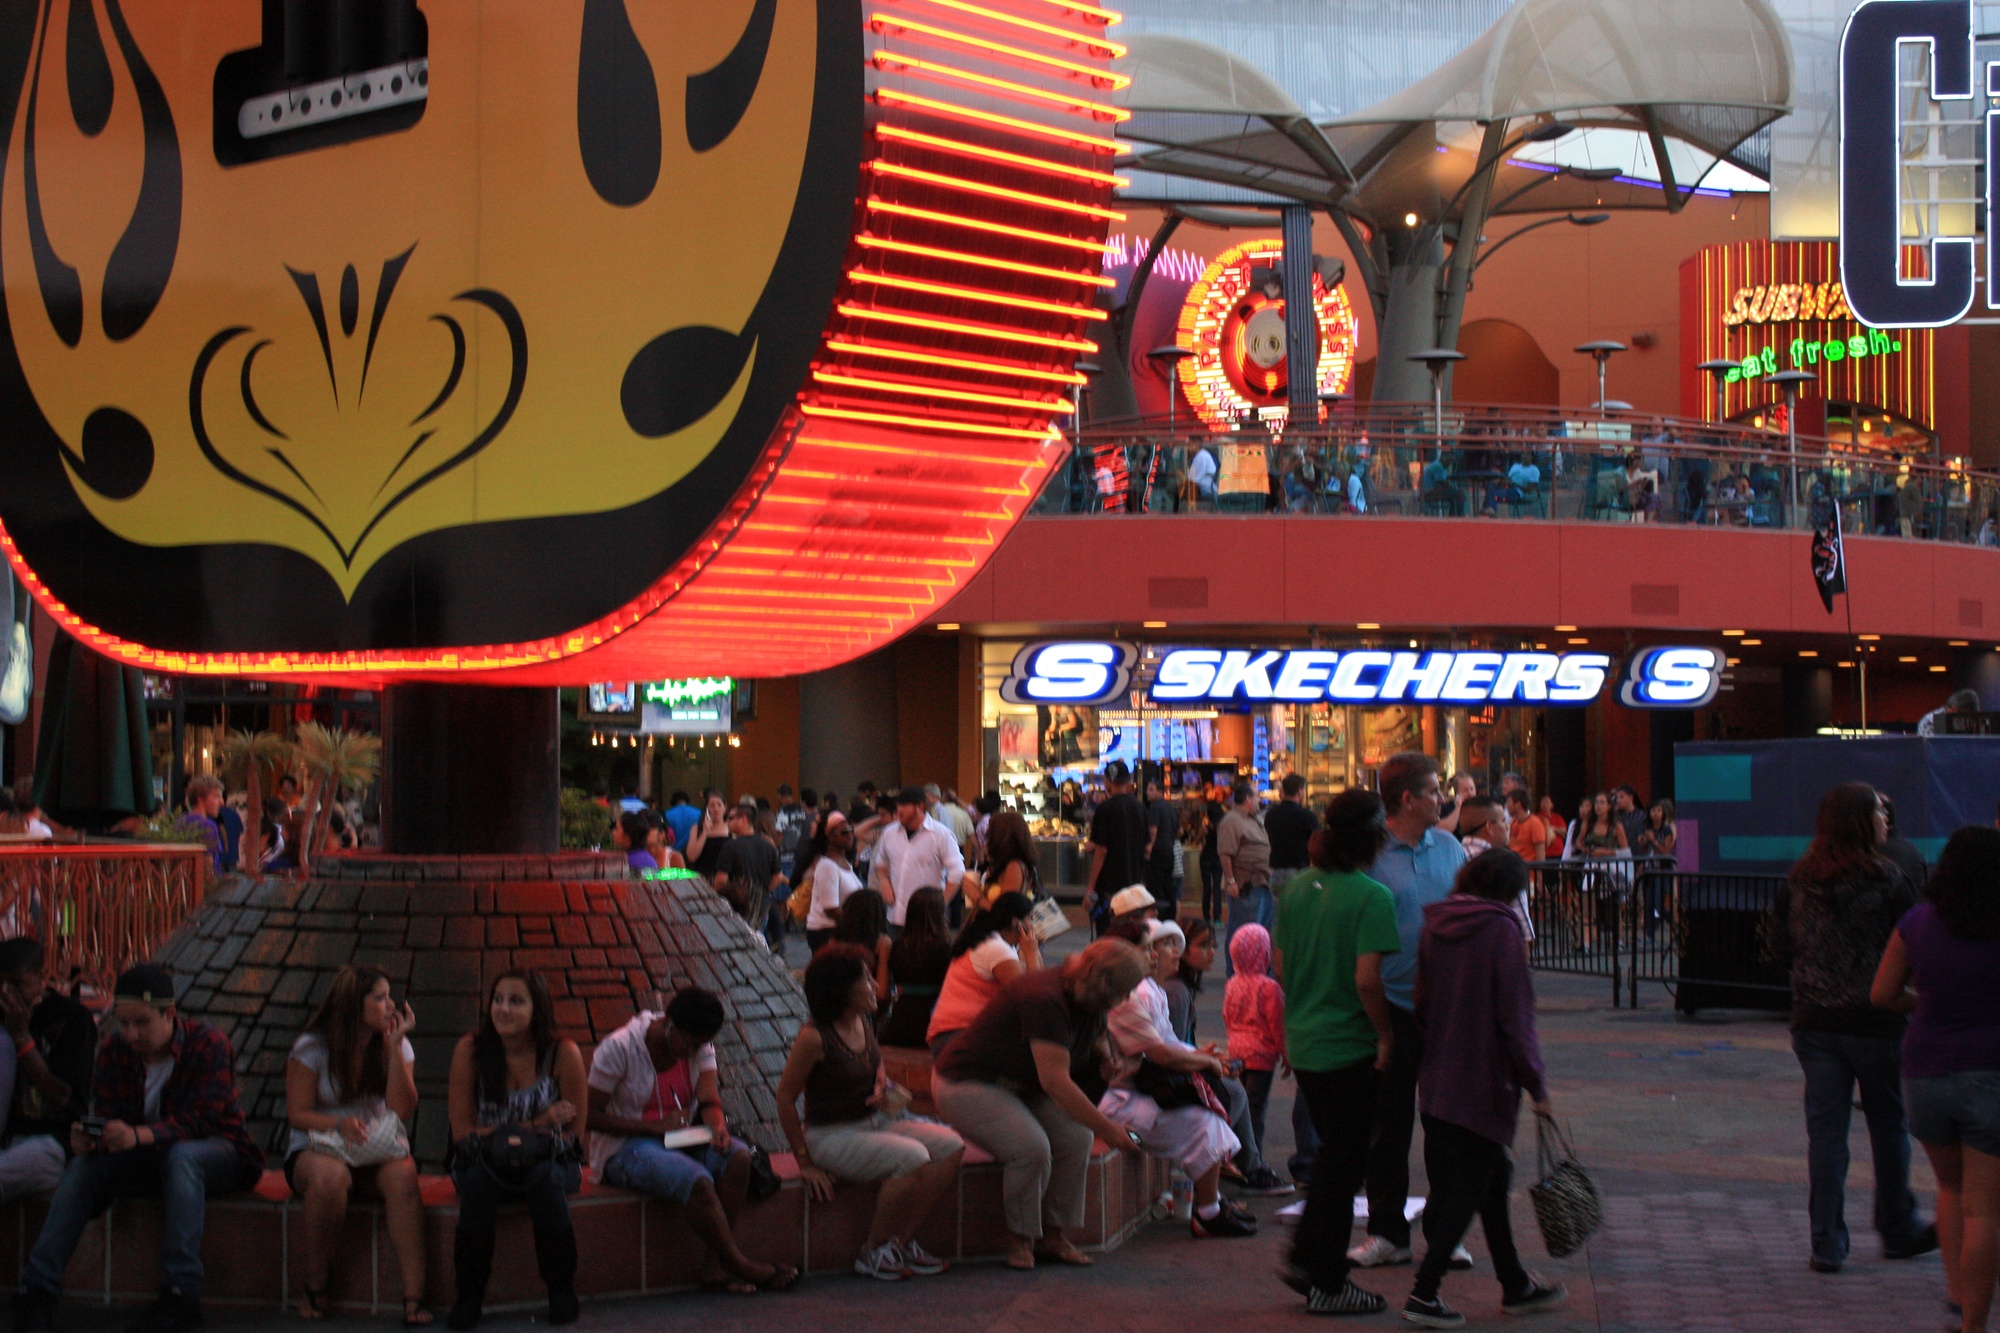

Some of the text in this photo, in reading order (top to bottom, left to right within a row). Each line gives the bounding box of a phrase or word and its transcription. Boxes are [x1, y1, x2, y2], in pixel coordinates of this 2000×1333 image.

[1840, 0, 2000, 328] C
[1722, 281, 1855, 326] SUBWA
[1724, 328, 1901, 383] eat fresh.
[1021, 641, 1120, 701] S
[1152, 648, 1611, 702] SKECHERS
